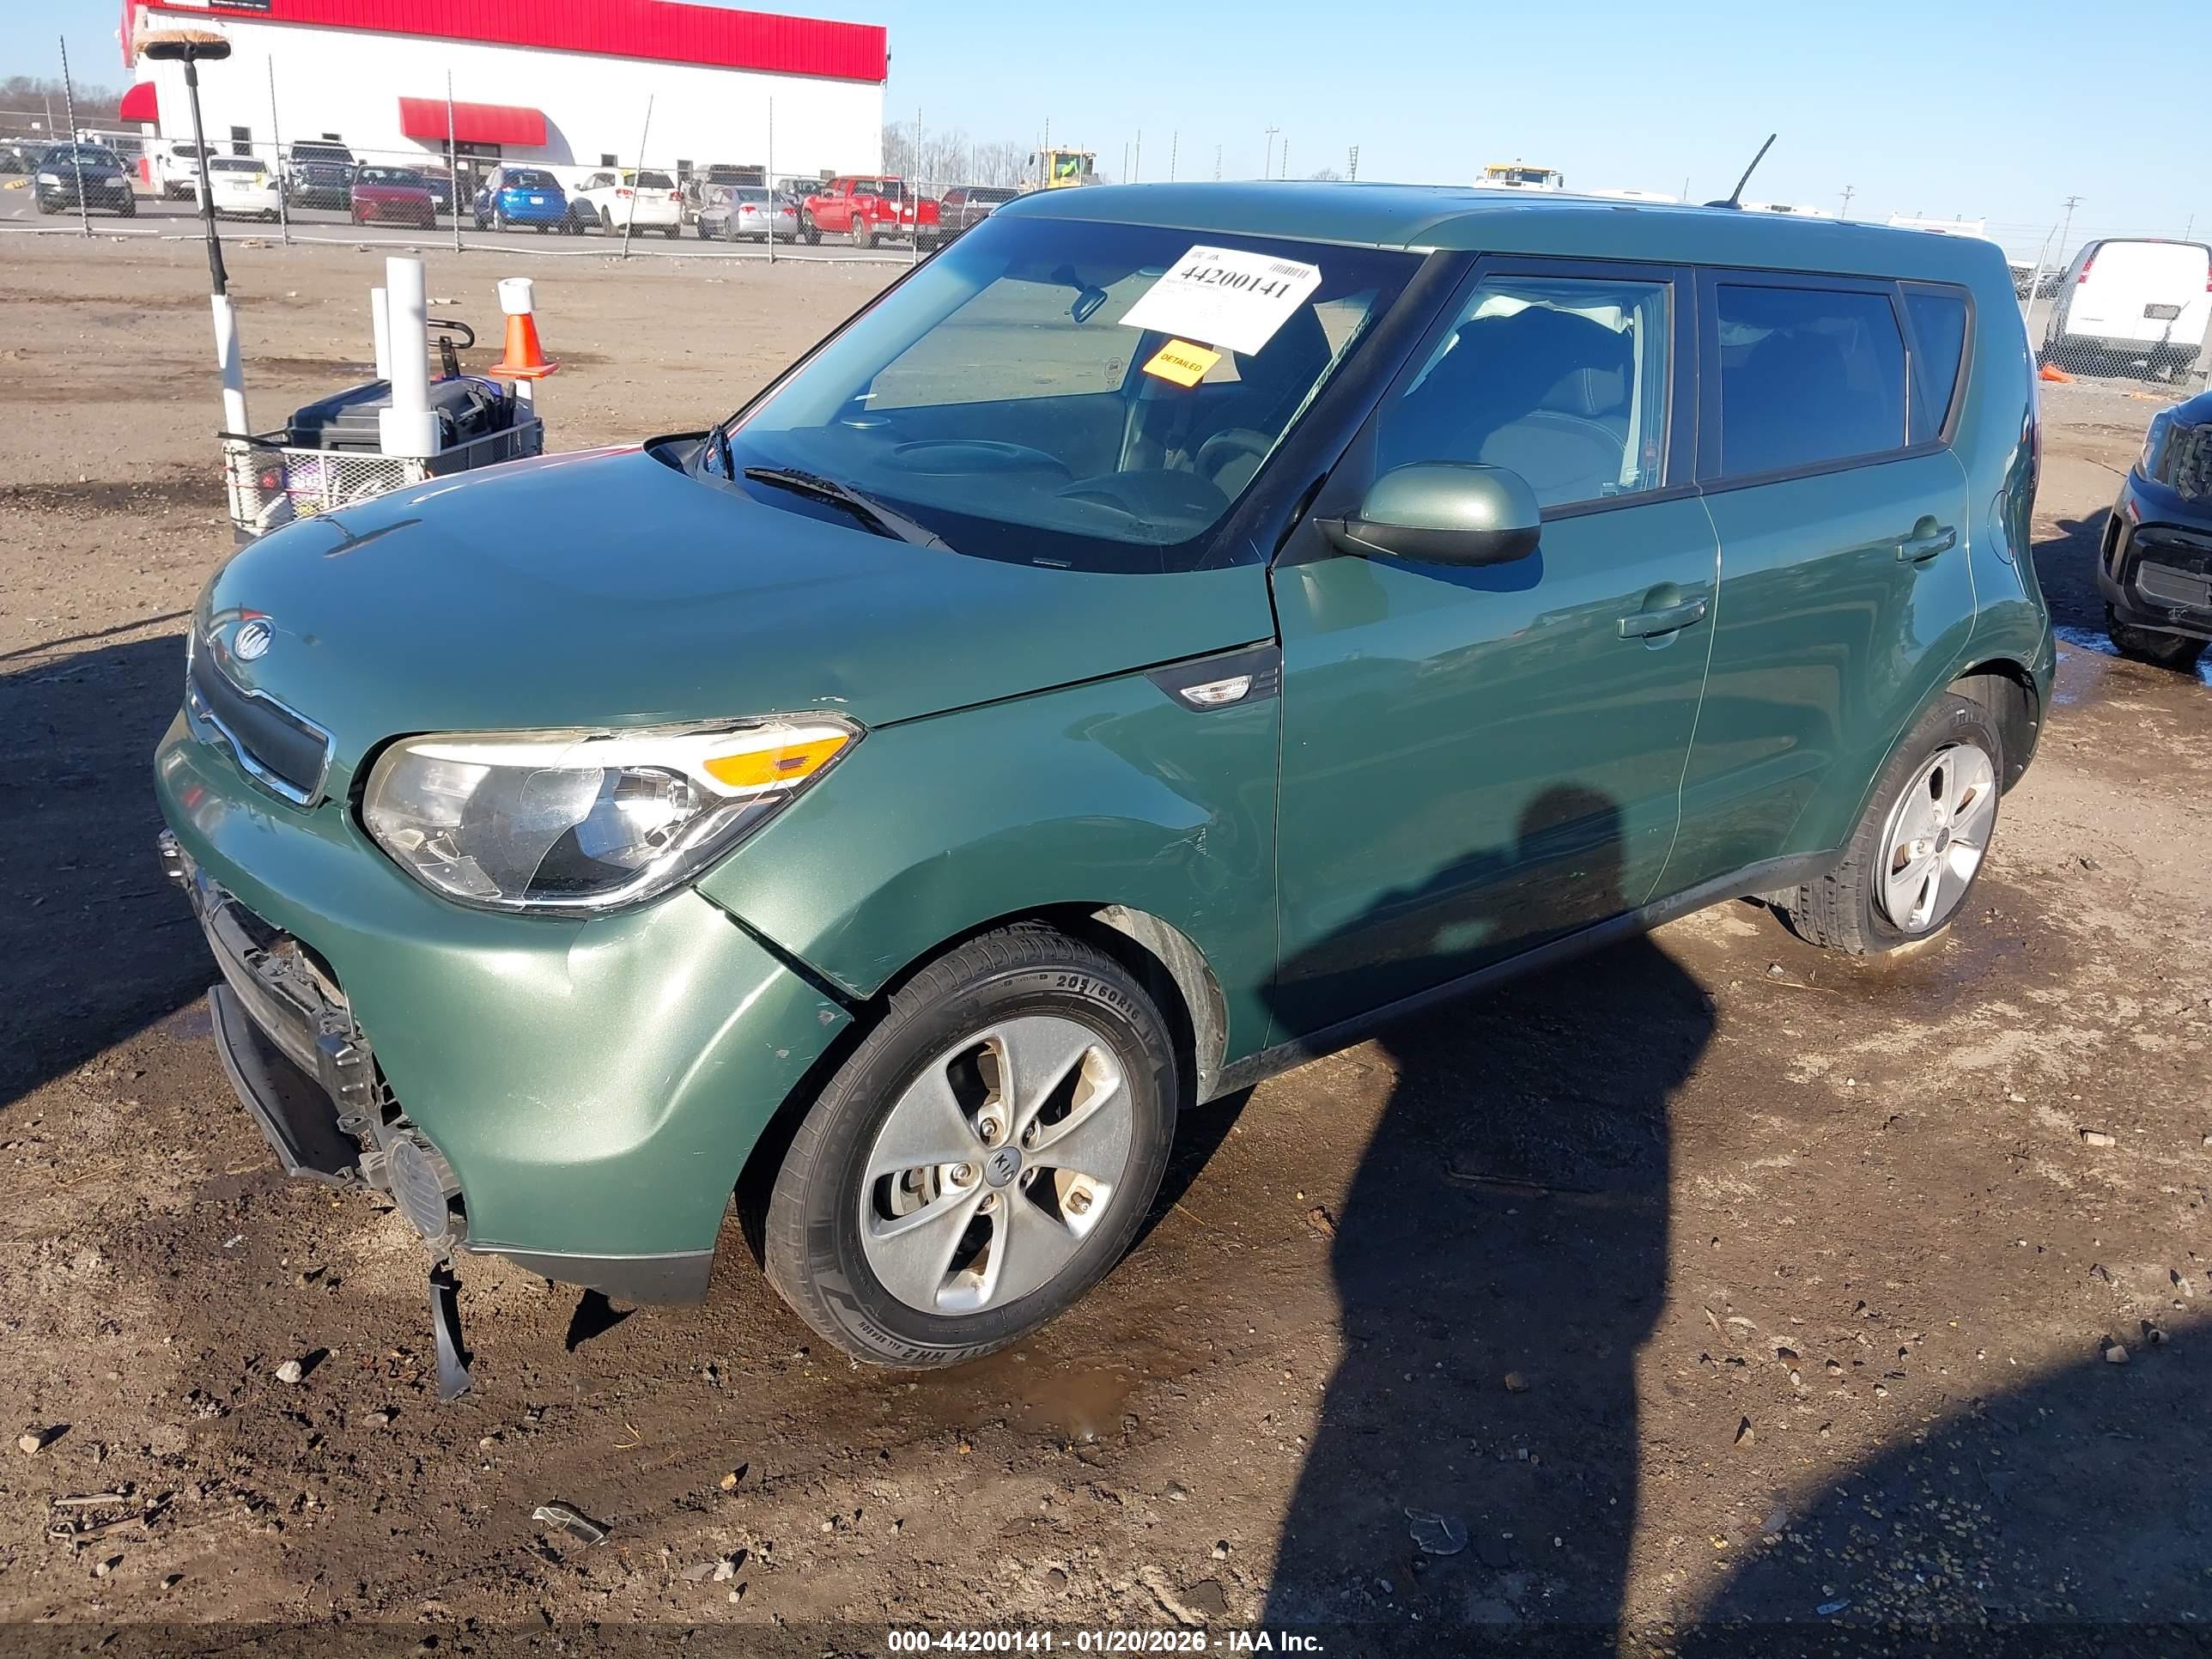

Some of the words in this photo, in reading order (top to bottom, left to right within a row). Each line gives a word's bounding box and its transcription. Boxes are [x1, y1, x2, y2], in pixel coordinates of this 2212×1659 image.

[1180, 265, 1291, 299] 44200141
[1160, 353, 1202, 373] DETAILED
[994, 1153, 1015, 1182] KIA
[858, 1321, 888, 1344] SEASON
[888, 1340, 903, 1351] ALL
